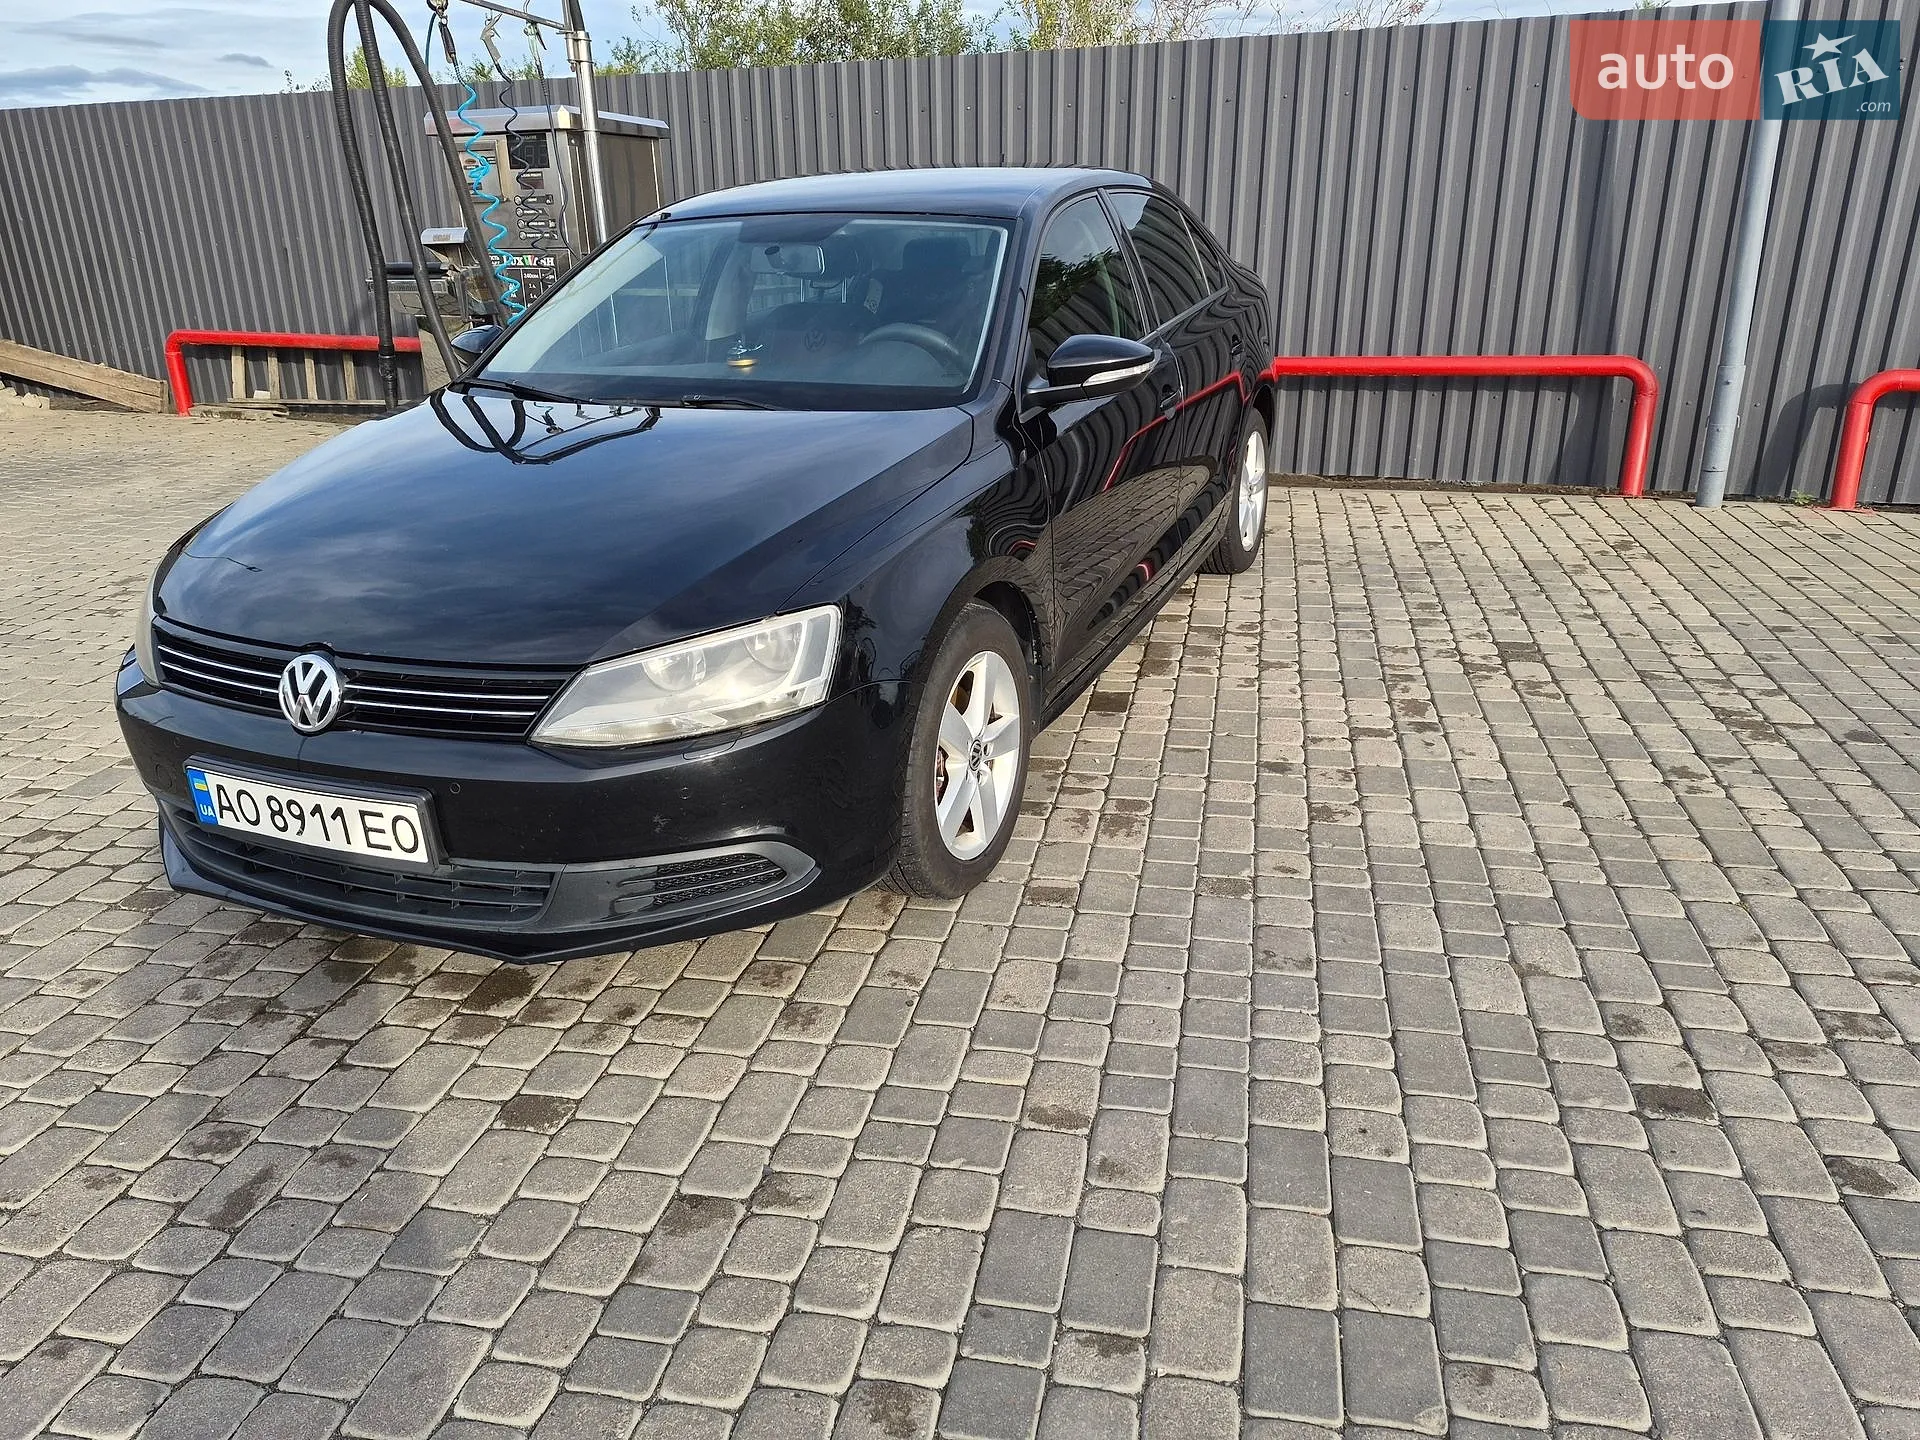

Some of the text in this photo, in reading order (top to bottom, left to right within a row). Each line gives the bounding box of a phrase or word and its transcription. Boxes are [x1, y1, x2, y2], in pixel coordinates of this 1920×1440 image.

[200, 804, 216, 817] UA
[216, 784, 419, 854] AO 8911 EO
